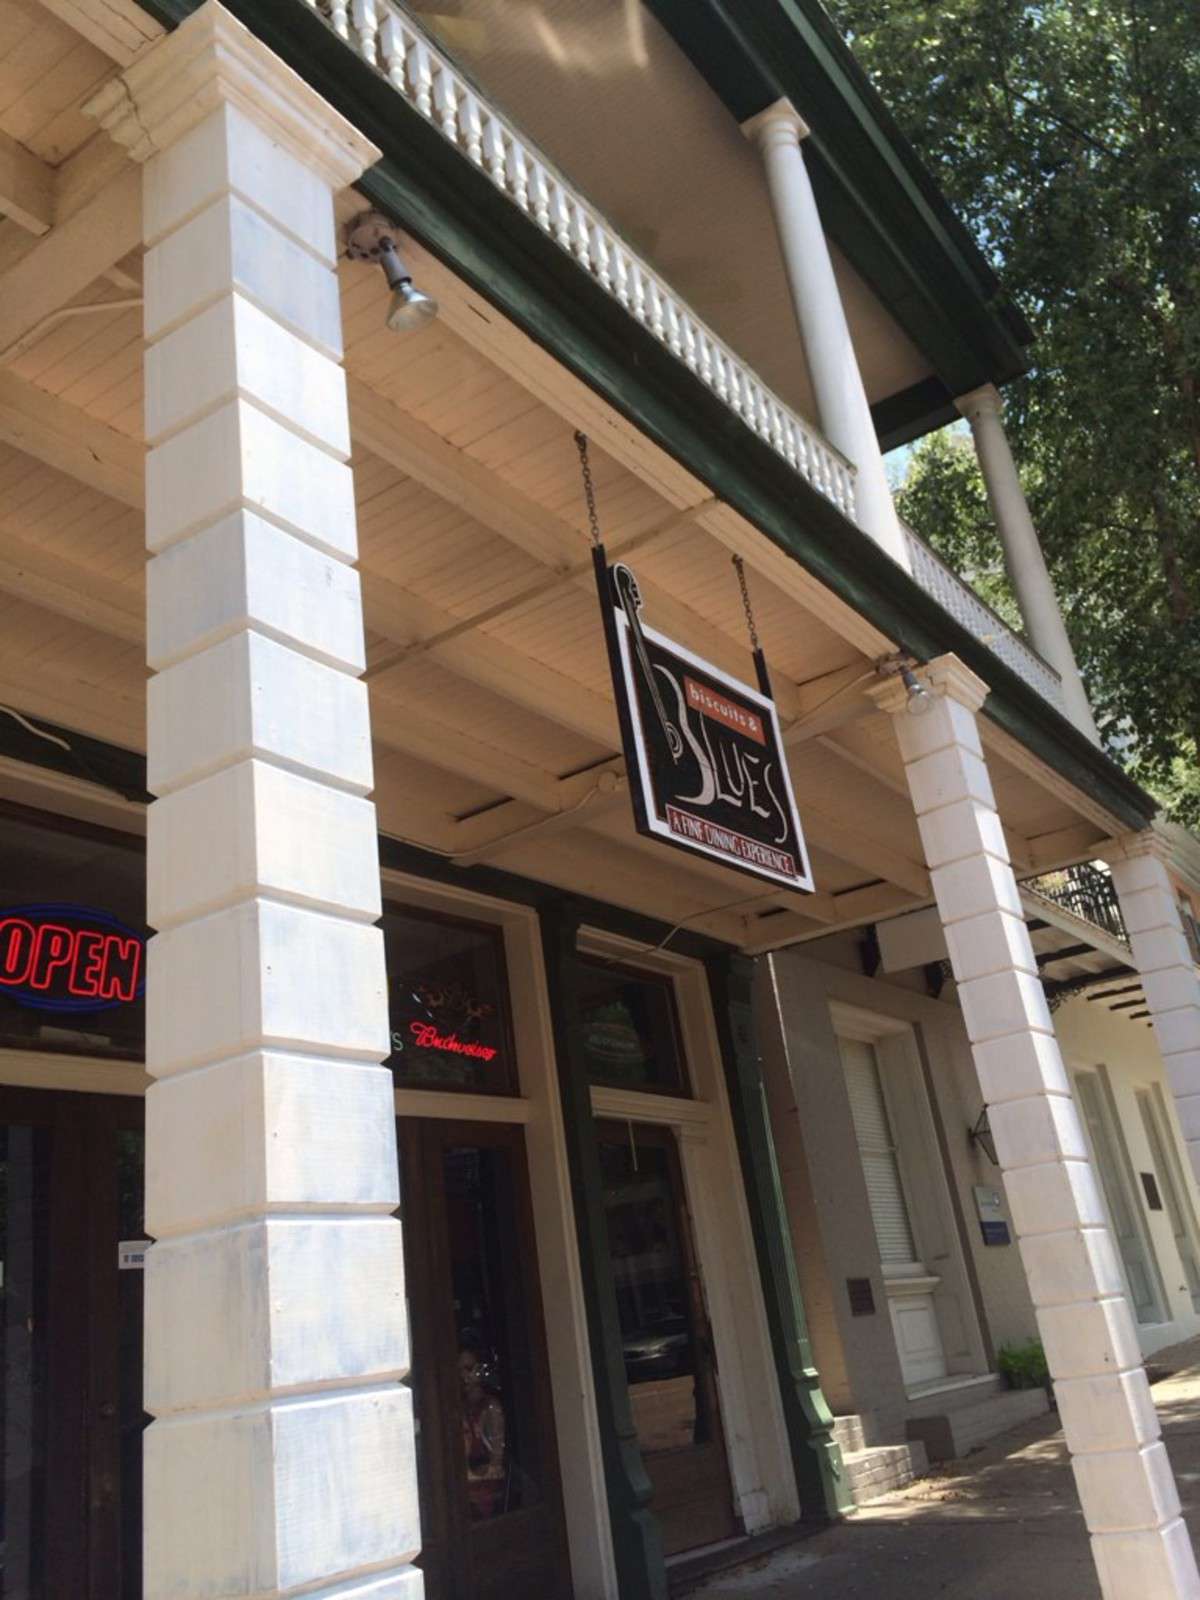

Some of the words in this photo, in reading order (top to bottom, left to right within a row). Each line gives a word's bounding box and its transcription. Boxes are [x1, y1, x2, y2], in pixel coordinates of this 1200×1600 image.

[688, 683, 747, 727] biscuits
[672, 811, 682, 833] A
[681, 815, 704, 841] FINE
[703, 823, 742, 856] DINING
[741, 838, 794, 876] EXPERIENCE
[0, 918, 141, 1001] OPEN
[409, 1021, 497, 1061] Budweiser
